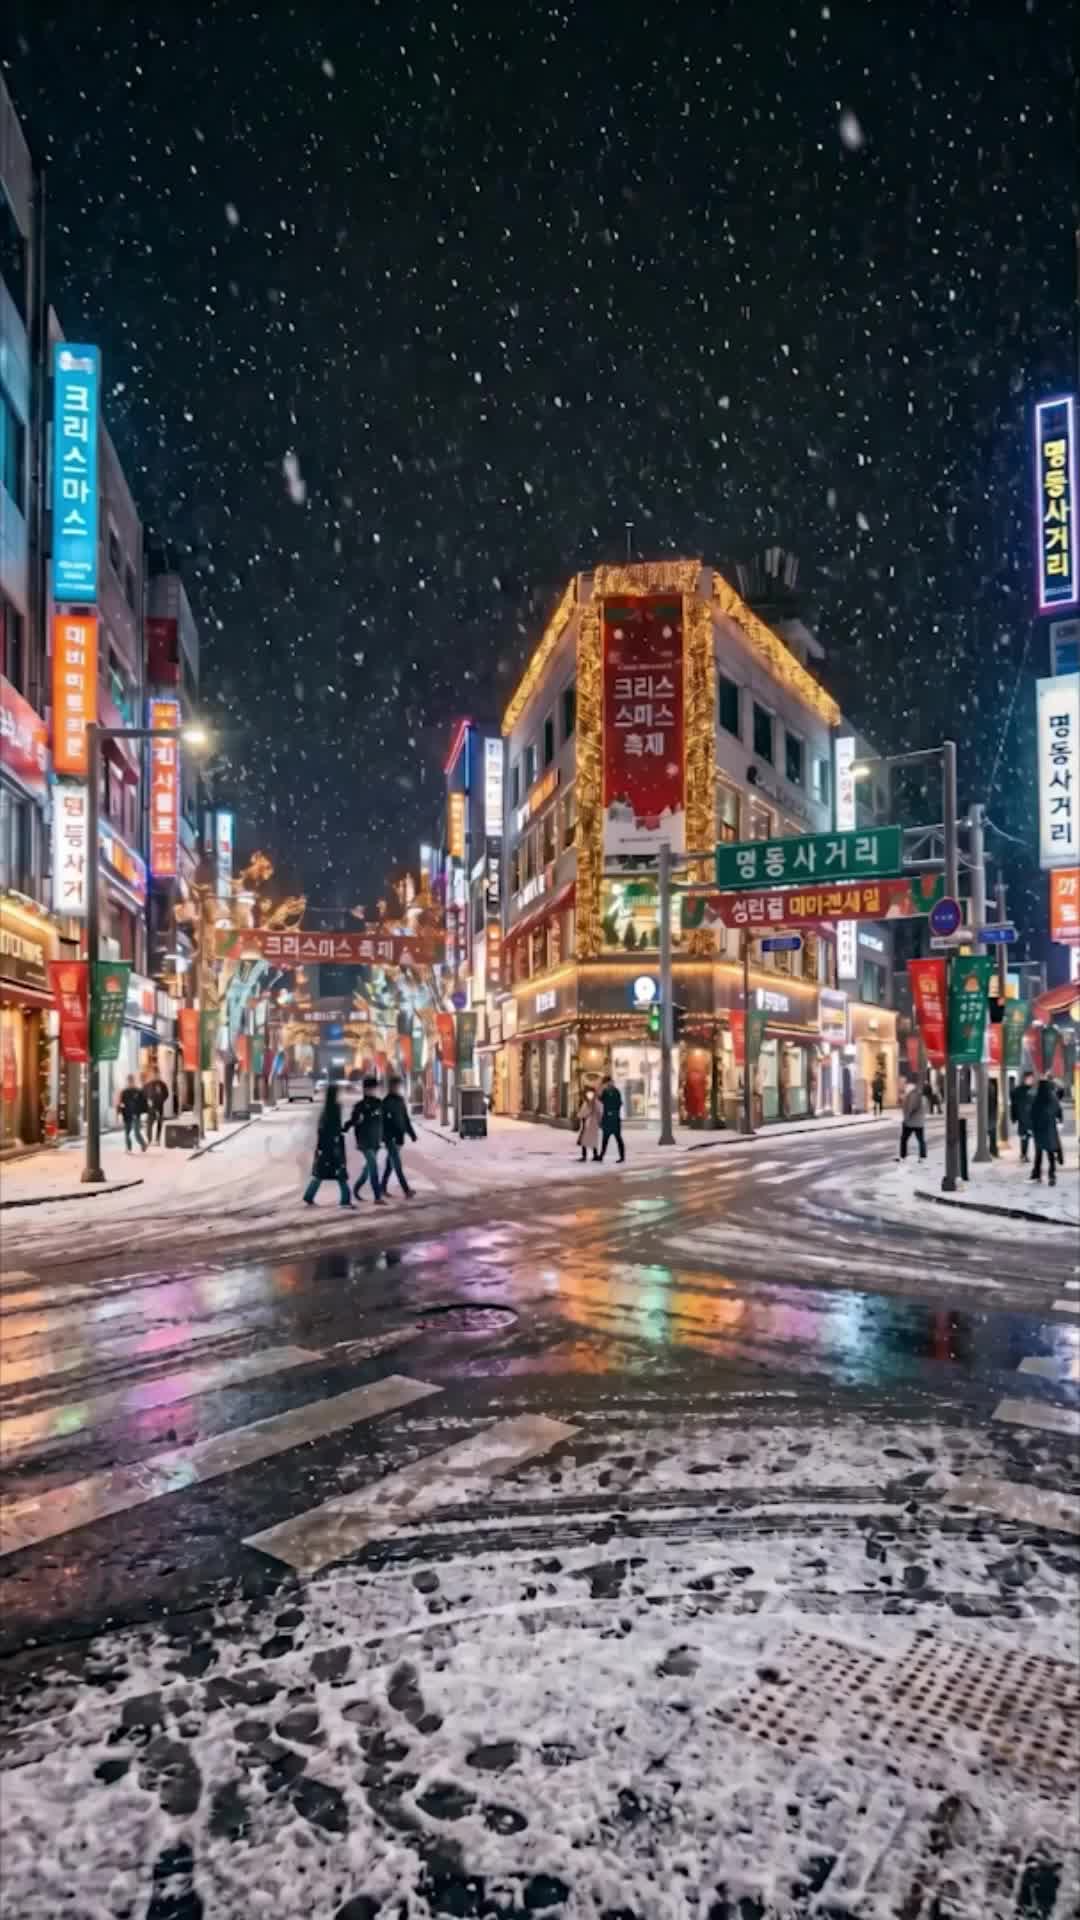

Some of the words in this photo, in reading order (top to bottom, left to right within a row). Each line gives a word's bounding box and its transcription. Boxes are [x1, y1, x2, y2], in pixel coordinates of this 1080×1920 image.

[62, 385, 90, 537] 크리스마스
[1044, 439, 1070, 577] 명동사거리
[614, 675, 675, 700] 크리스
[614, 704, 675, 728] 스미스
[1048, 712, 1072, 844] 명동사거리
[736, 836, 879, 879] 명동사거리
